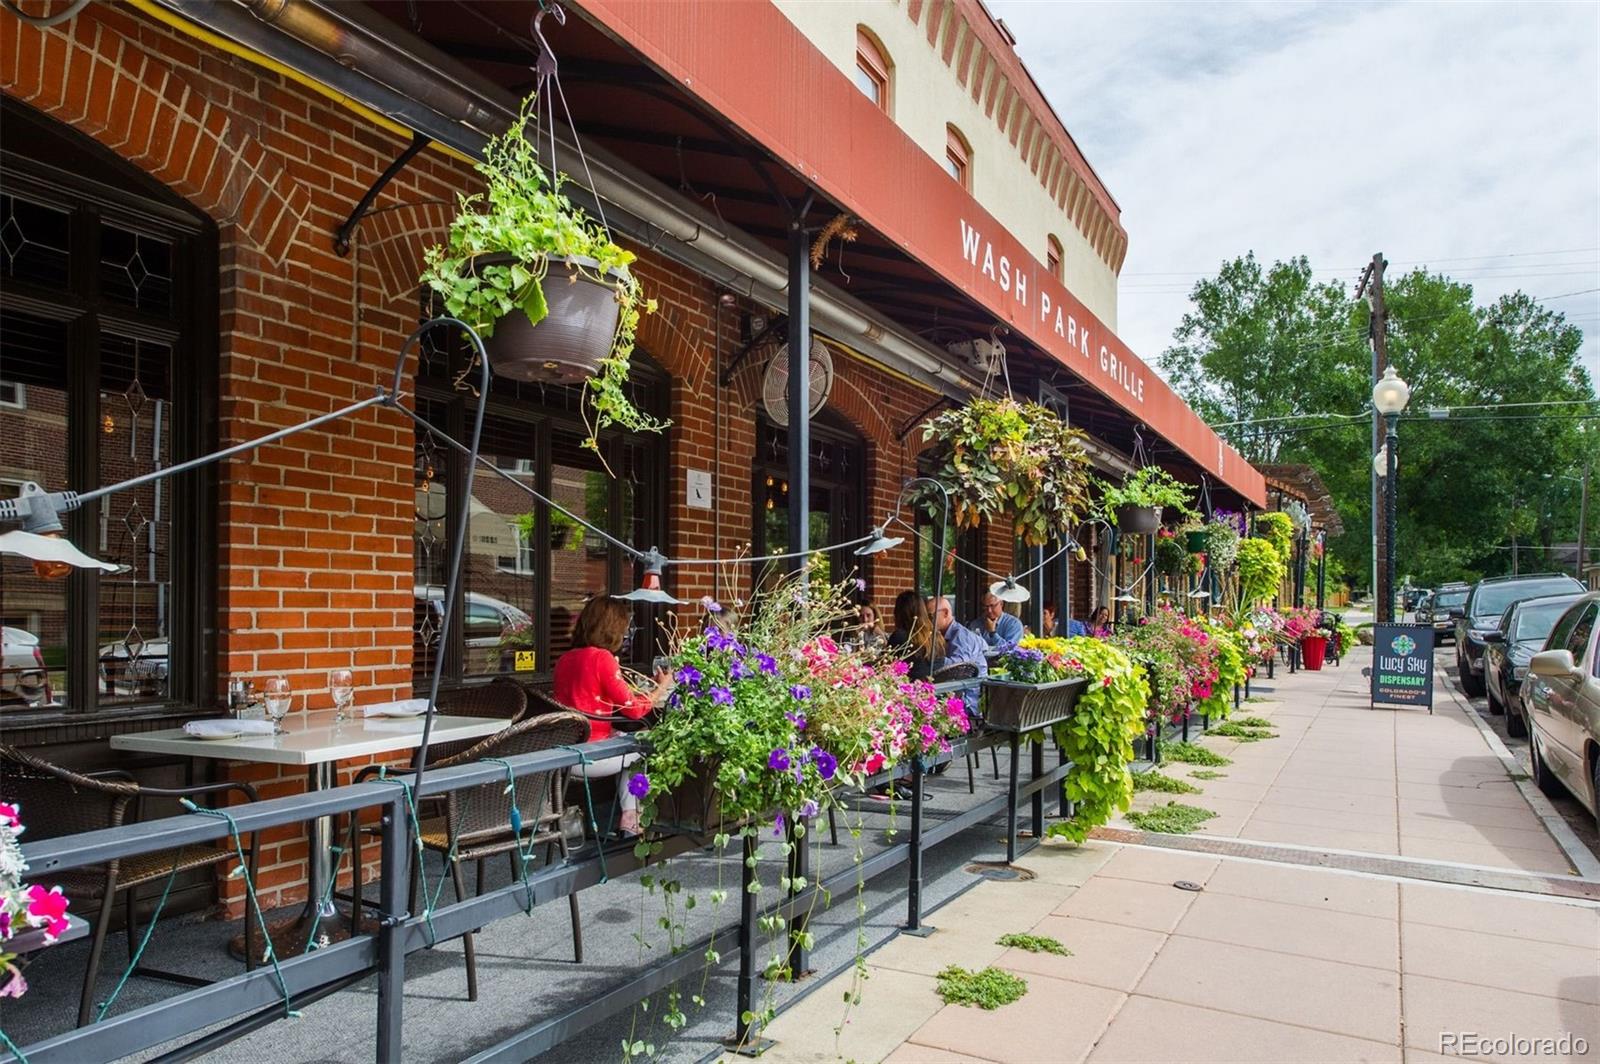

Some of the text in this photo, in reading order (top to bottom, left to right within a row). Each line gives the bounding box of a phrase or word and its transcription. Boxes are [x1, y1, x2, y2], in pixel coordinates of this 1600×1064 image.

[960, 219, 1144, 404] WASH PARK GRILLE
[1379, 674, 1426, 686] DISPENSARY
